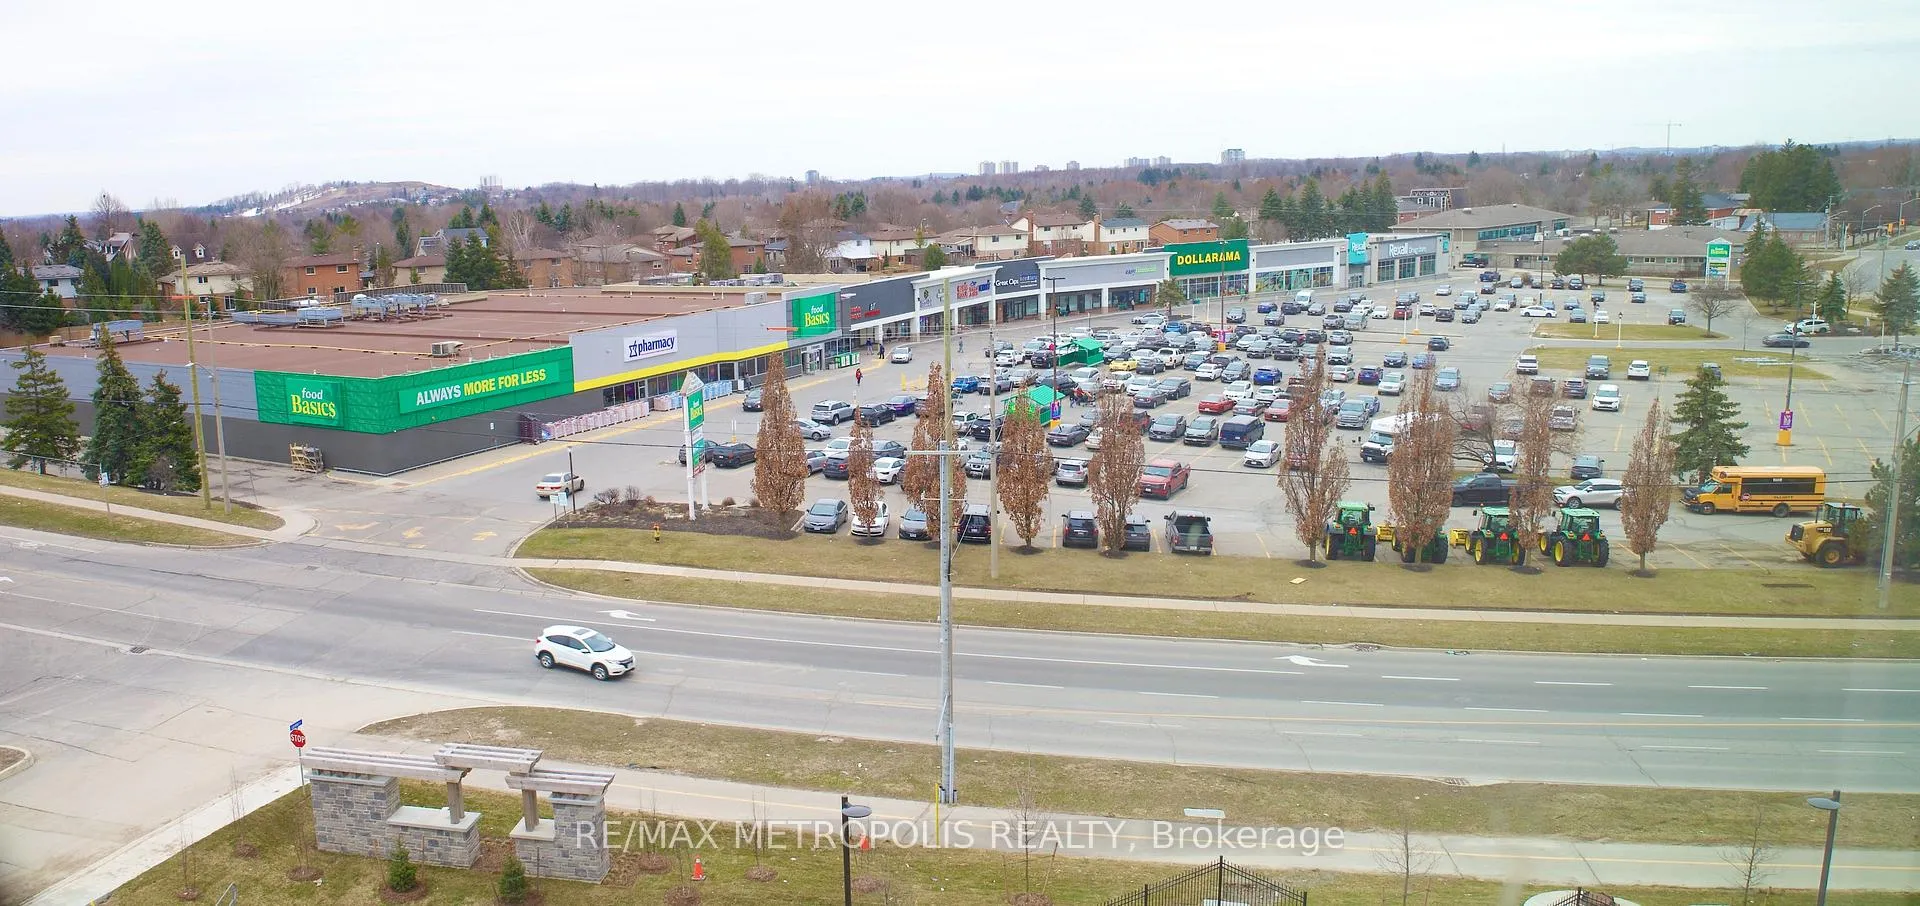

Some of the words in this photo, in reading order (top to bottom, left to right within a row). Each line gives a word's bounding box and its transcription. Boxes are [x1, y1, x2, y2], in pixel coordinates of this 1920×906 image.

[1389, 242, 1409, 257] Rexall
[1177, 251, 1241, 266] DOLLARAMA
[811, 304, 824, 314] food
[637, 336, 675, 356] pharmacy
[301, 387, 324, 400] food
[416, 384, 462, 406] ALWAYS
[463, 378, 496, 396] MORE
[498, 373, 520, 389] FOR
[520, 368, 547, 385] LESS
[290, 734, 306, 743] STOP
